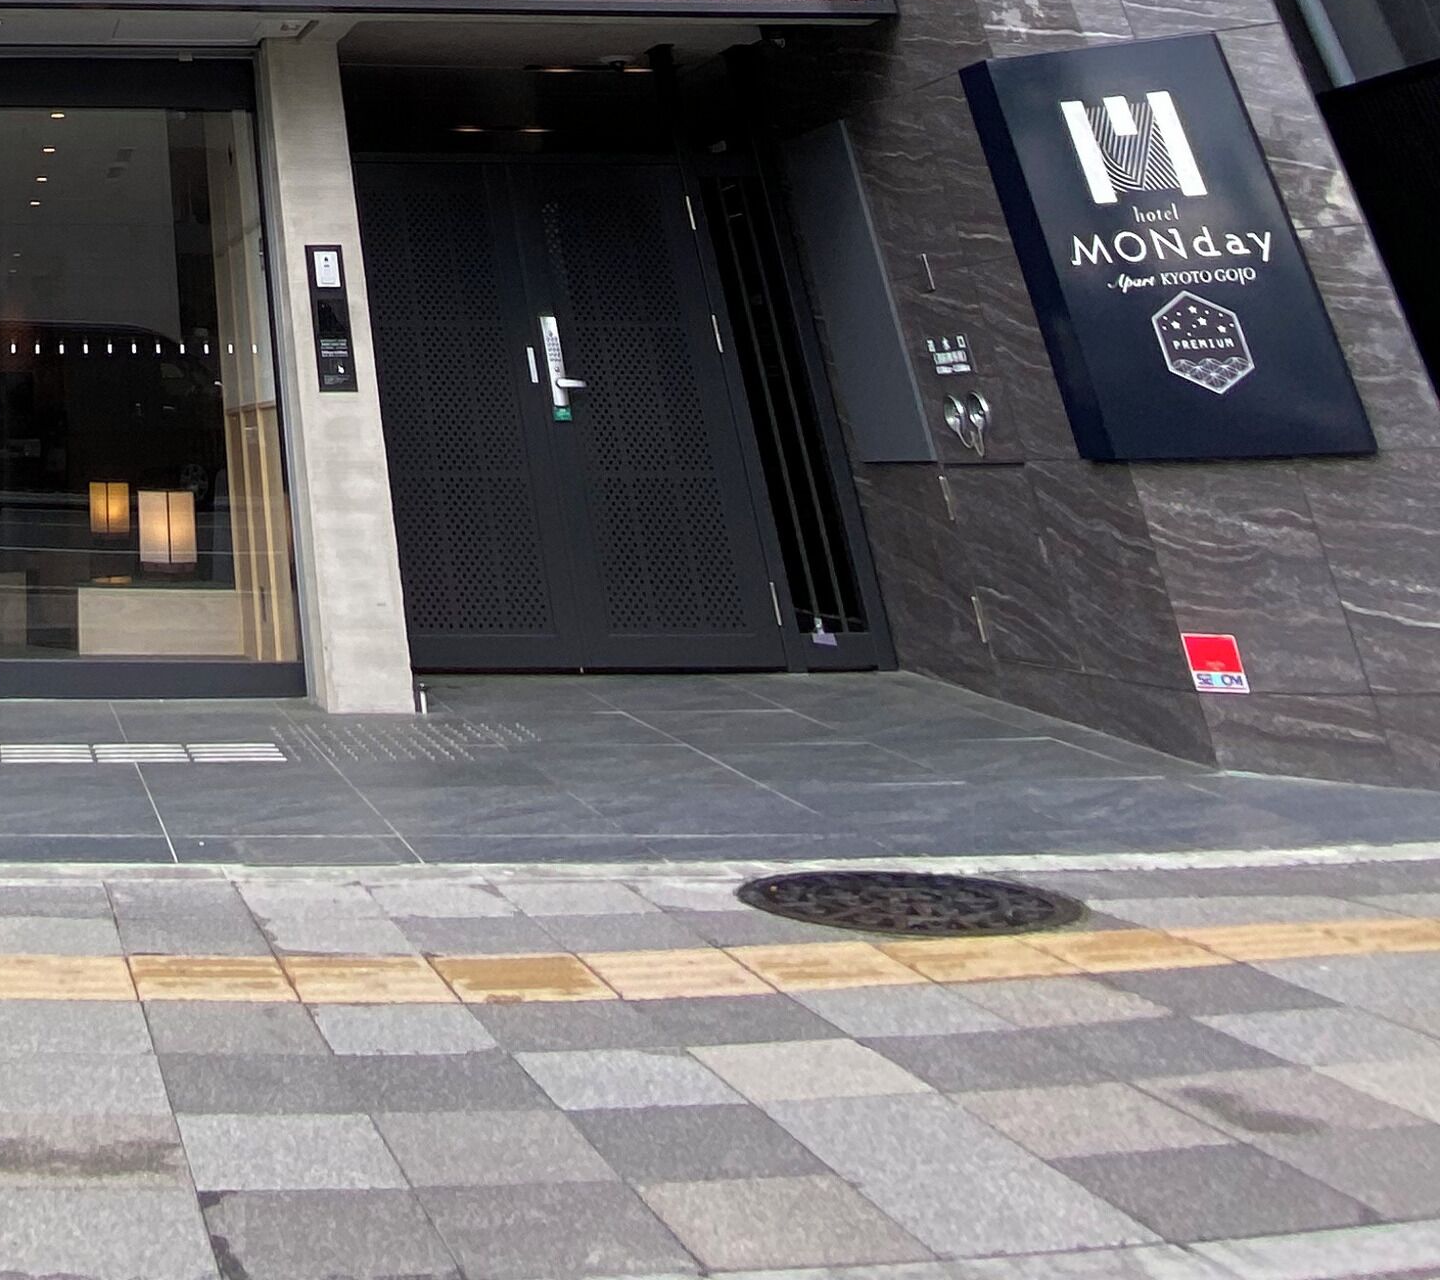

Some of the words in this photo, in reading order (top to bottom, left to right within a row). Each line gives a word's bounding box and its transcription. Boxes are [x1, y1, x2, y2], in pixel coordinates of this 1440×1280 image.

[1132, 202, 1180, 223] hotel
[1071, 225, 1271, 266] MONday
[1107, 273, 1155, 293] Apart
[1160, 269, 1212, 286] KYOTO
[1214, 267, 1257, 285] GOJO
[1172, 337, 1236, 351] PREMIUM
